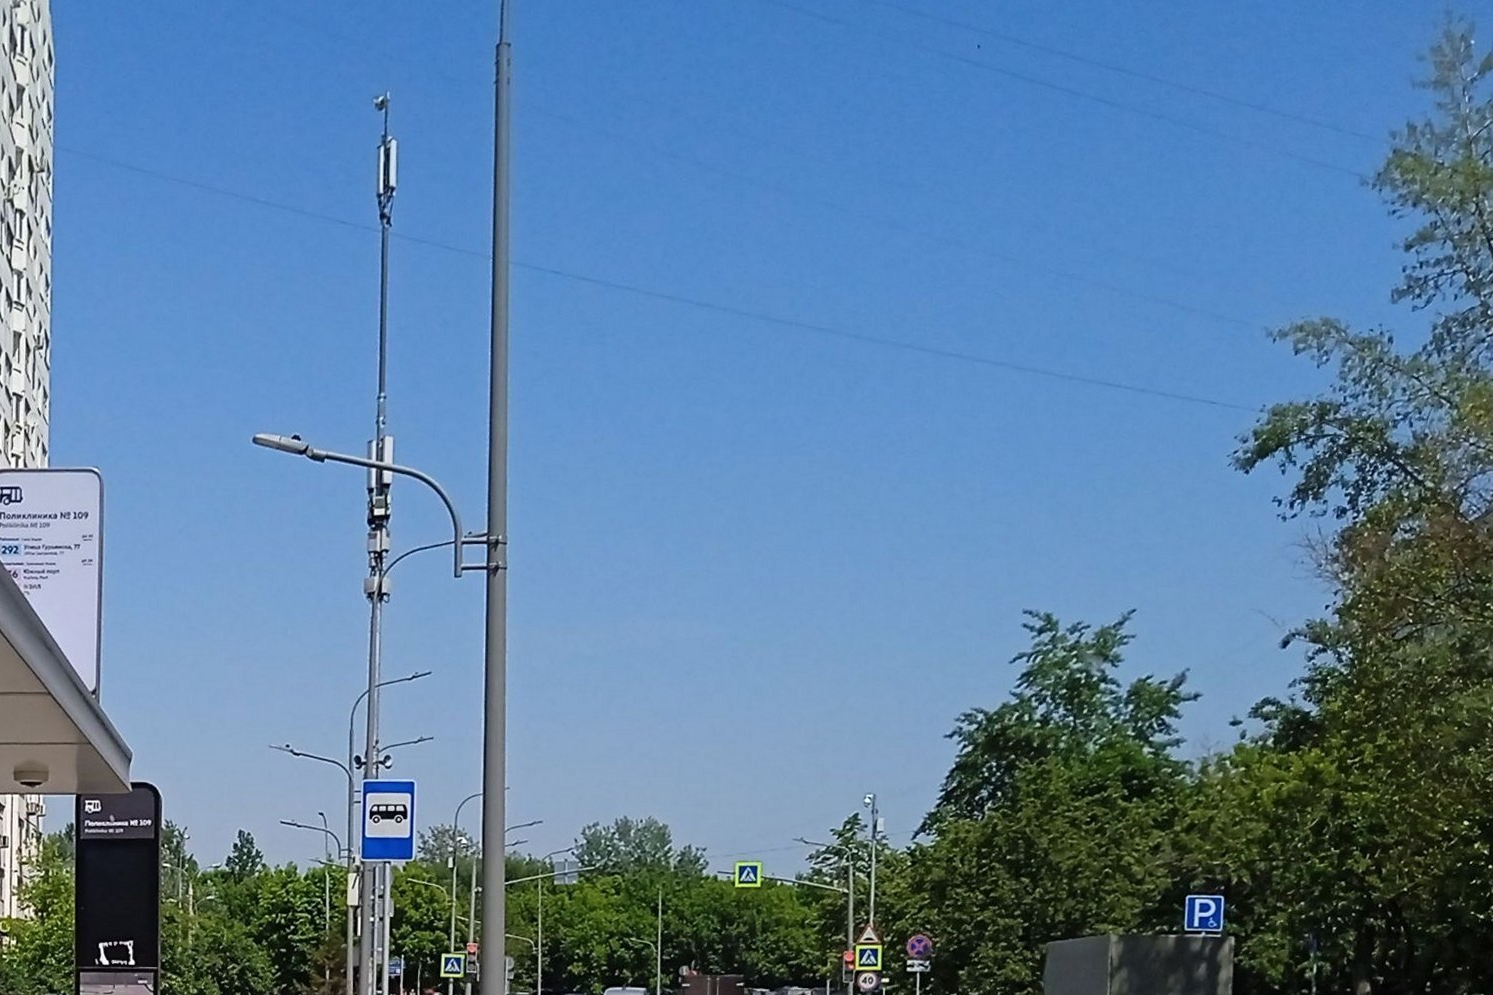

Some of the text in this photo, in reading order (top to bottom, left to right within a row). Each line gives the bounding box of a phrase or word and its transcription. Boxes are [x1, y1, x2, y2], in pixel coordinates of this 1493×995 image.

[0, 511, 58, 520] Поликлиника
[73, 511, 89, 519] 109
[1, 545, 20, 555] 292
[1193, 899, 1216, 927] P
[861, 976, 874, 985] 40
